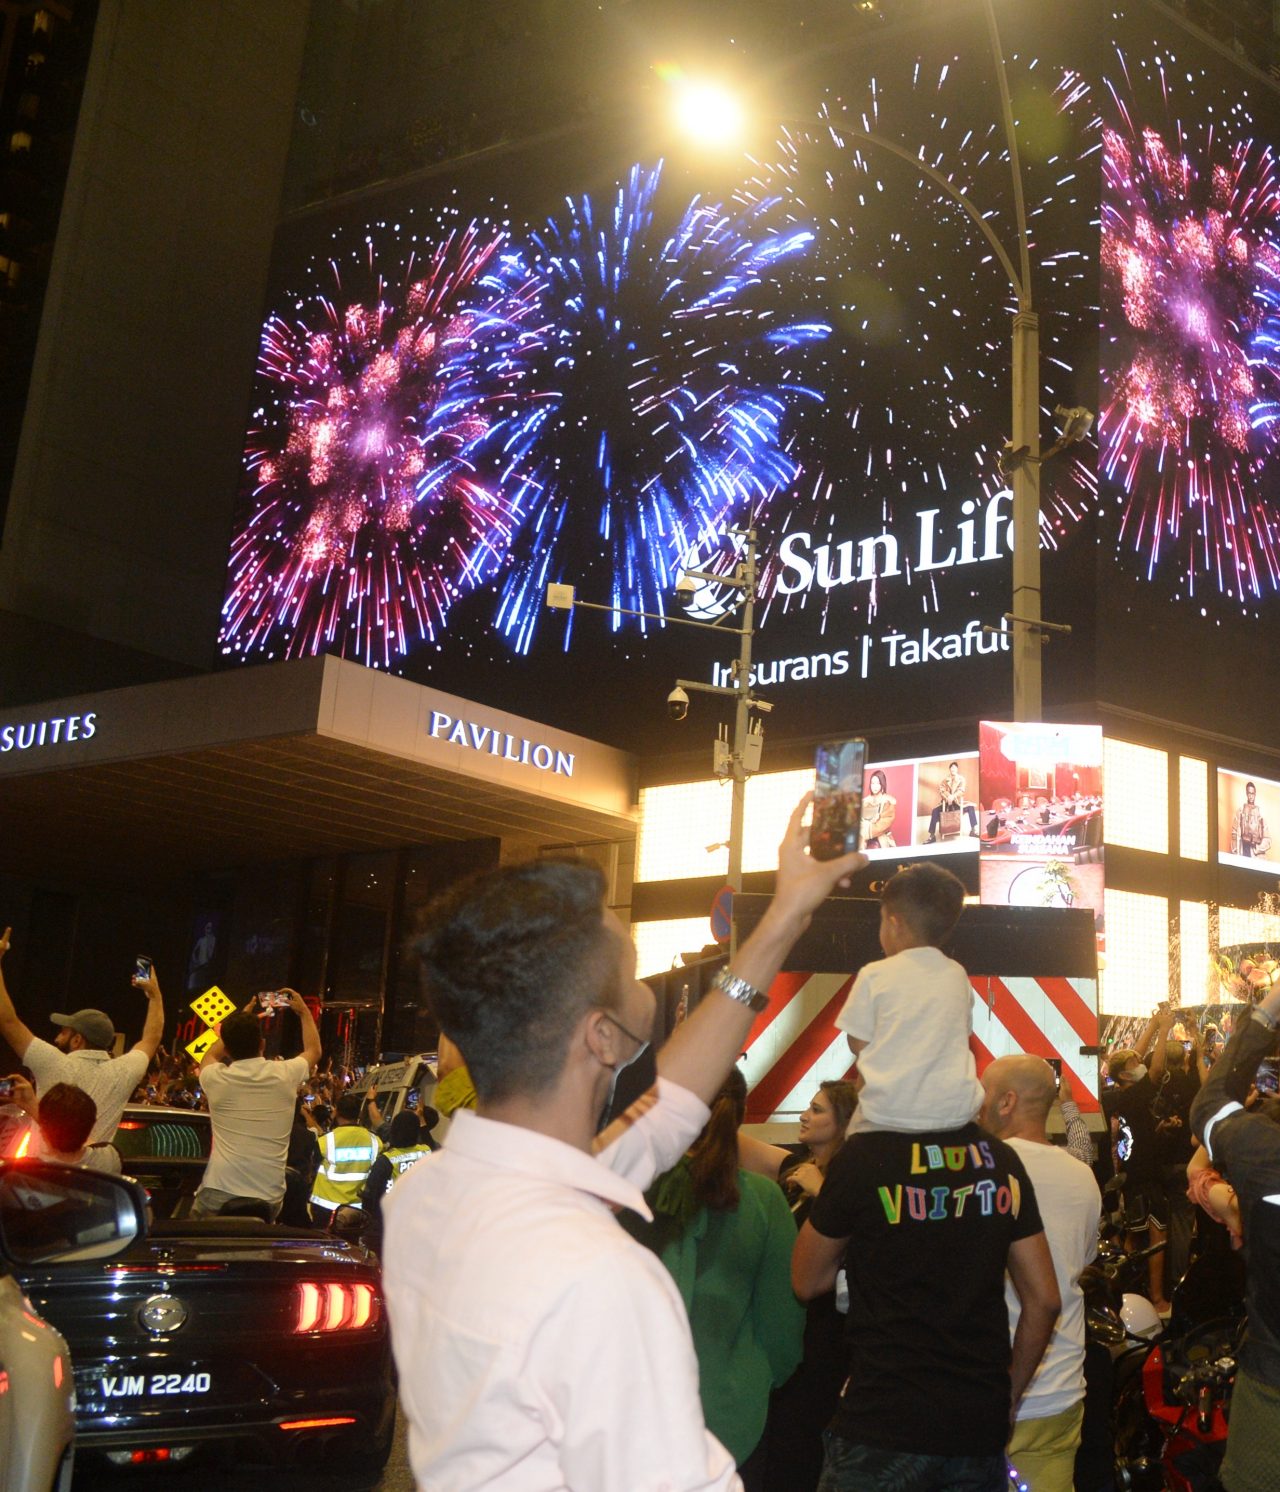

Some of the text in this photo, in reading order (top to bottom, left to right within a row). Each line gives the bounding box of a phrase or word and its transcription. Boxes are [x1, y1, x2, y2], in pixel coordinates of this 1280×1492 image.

[777, 532, 902, 595] Sun
[881, 616, 1010, 667] Takaful
[0, 712, 97, 753] SUITES
[428, 711, 577, 778] PAVILION
[102, 1373, 211, 1397] VJM 2240
